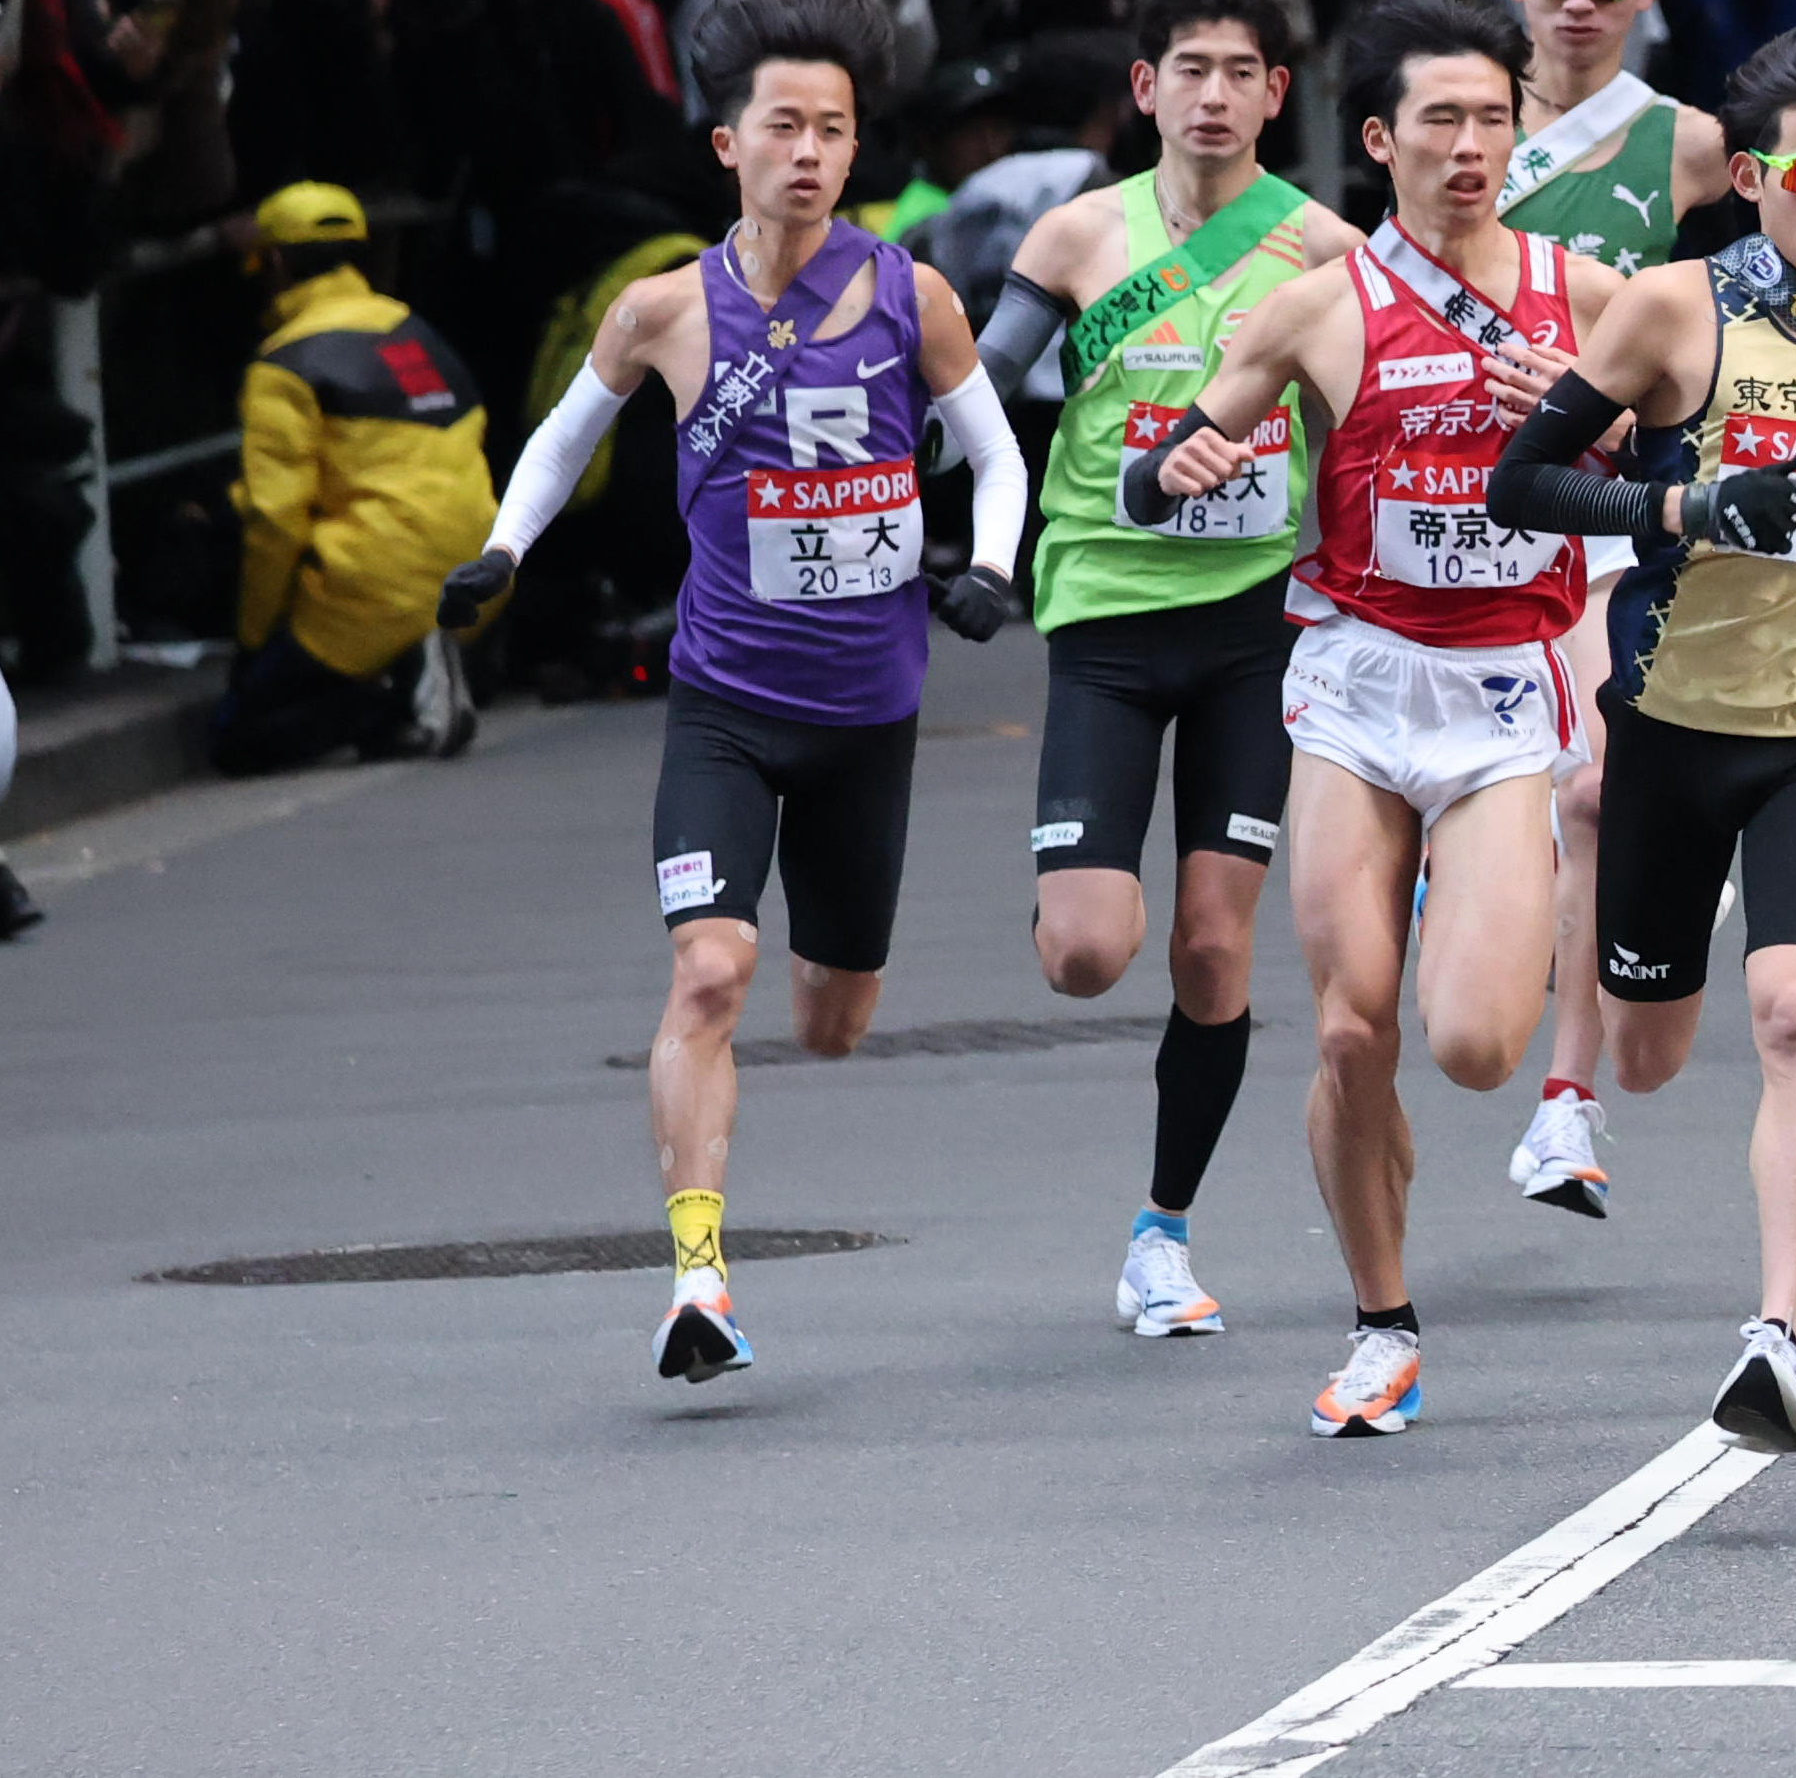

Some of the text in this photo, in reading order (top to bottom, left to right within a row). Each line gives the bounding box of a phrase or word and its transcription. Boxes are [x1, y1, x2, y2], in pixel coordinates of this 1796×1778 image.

[688, 350, 773, 458] 立教大学
[784, 385, 875, 469] R
[792, 472, 914, 512] SAPPOR
[799, 565, 892, 596] 20-13
[1427, 554, 1520, 584] 10-14
[1608, 958, 1672, 980] SAINT
